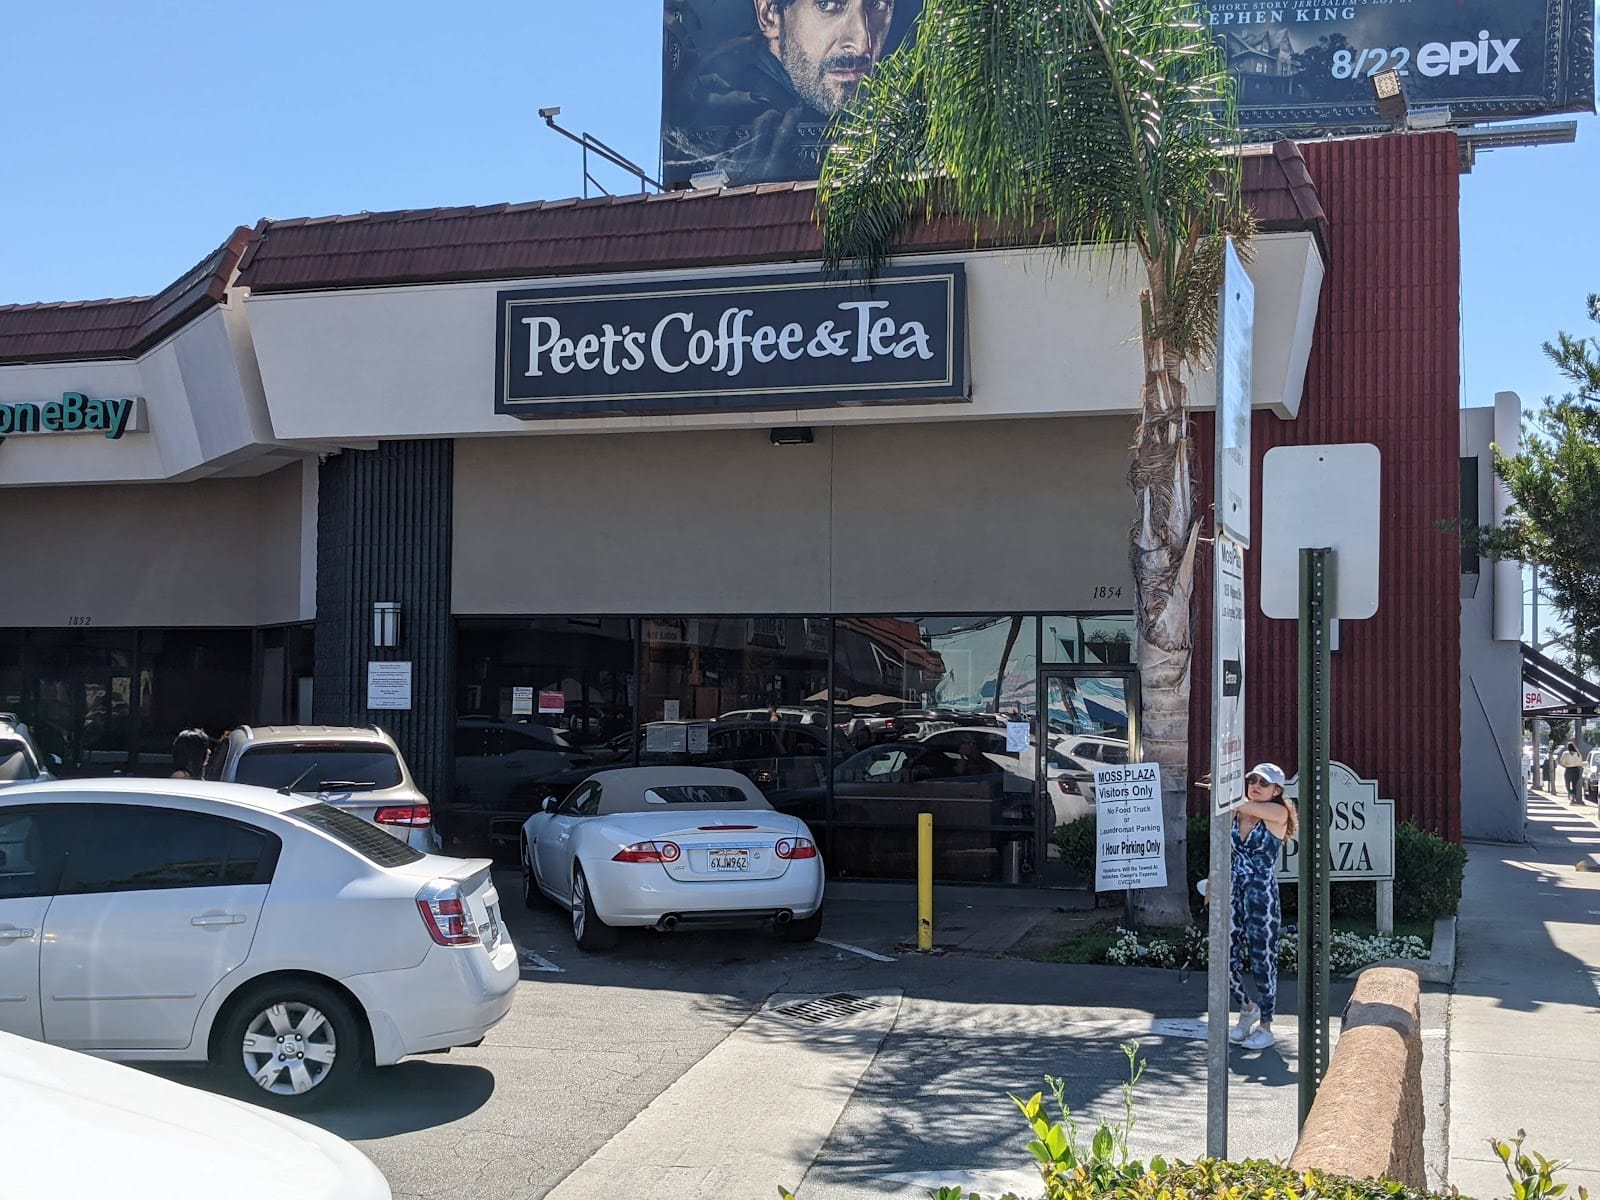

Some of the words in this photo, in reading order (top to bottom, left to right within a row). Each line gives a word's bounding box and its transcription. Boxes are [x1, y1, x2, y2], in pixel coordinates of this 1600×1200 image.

[1212, 3, 1248, 11] SHORT
[1253, 1, 1288, 10] STORY
[1197, 10, 1283, 25] EPHEN
[1296, 7, 1355, 21] KING
[1331, 47, 1410, 79] 8/22
[1416, 30, 1521, 77] epix
[521, 316, 646, 377] Peet's
[651, 308, 803, 377] Coffee
[838, 301, 934, 362] Tea
[1093, 586, 1122, 599] 1854
[1525, 693, 1542, 704] SPA
[1098, 771, 1123, 783] MOSS
[1125, 769, 1156, 780] PLAZA
[1099, 787, 1129, 799] Visitors
[1132, 785, 1153, 797] Only
[1116, 806, 1131, 814] Food
[1133, 805, 1151, 813] Truck
[1100, 827, 1134, 836] Laundromat
[1136, 824, 1161, 832] Parking
[1106, 842, 1120, 857] Hour
[1122, 840, 1145, 857] Parking
[1146, 840, 1161, 855] Only
[1279, 839, 1374, 873] PZA
